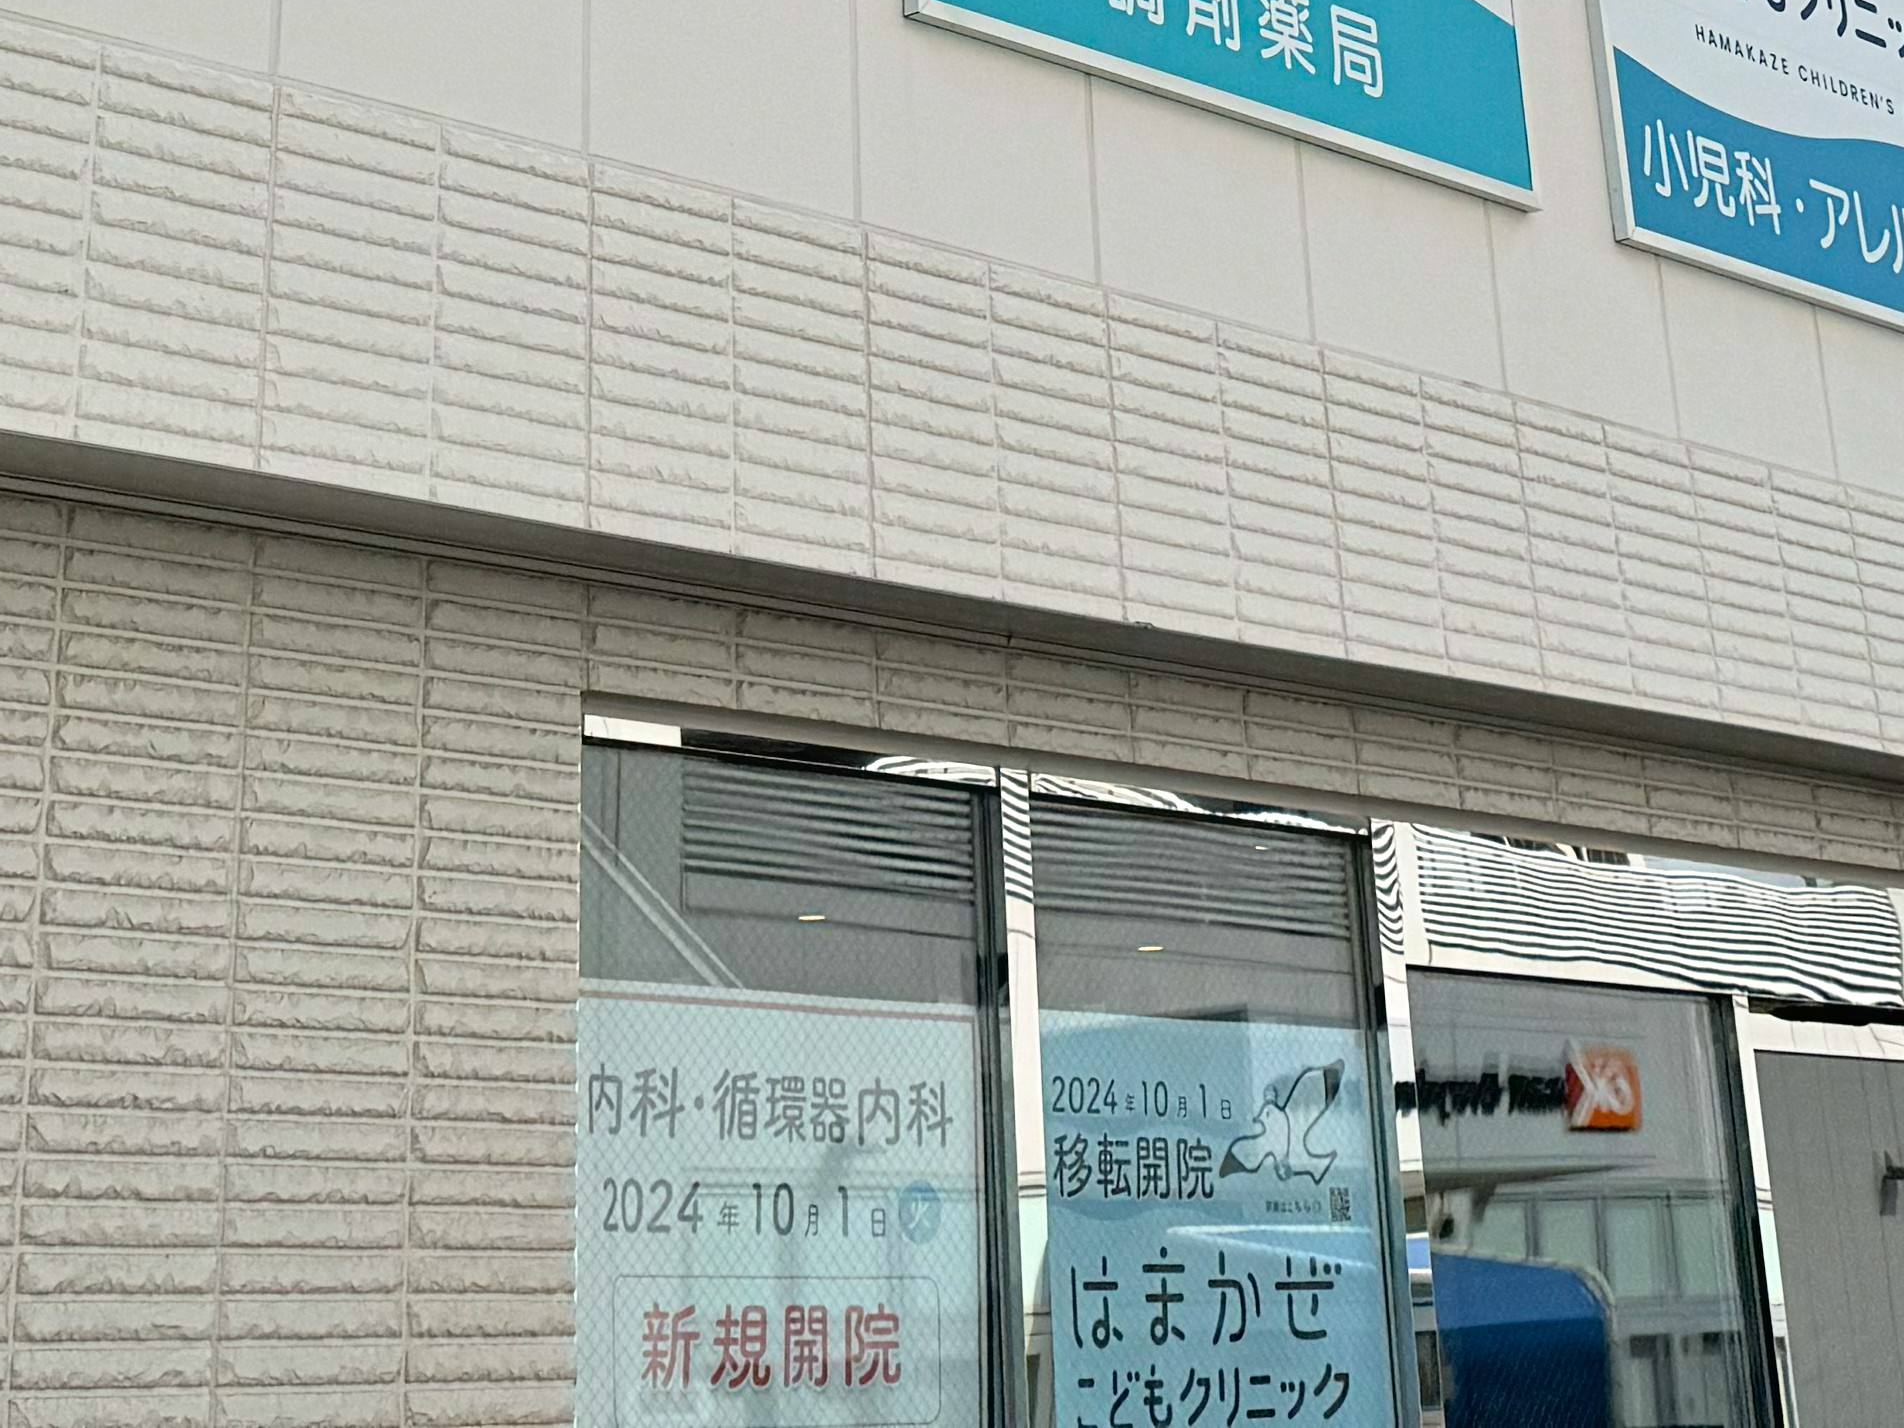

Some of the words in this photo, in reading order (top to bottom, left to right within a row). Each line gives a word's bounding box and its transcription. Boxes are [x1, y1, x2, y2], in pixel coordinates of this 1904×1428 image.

[1695, 24, 1789, 76] HAMAKAZE
[1798, 65, 1895, 116] CHILDREN'S
[588, 1063, 954, 1147] 内科・循環器内科
[1052, 1075, 1232, 1119] 2024年10月1日
[1054, 1132, 1214, 1200] 移転開院
[1071, 1246, 1342, 1349] はまかぜ
[641, 1302, 902, 1389] 新規開院
[1077, 1363, 1350, 1428] こどもクリニック
